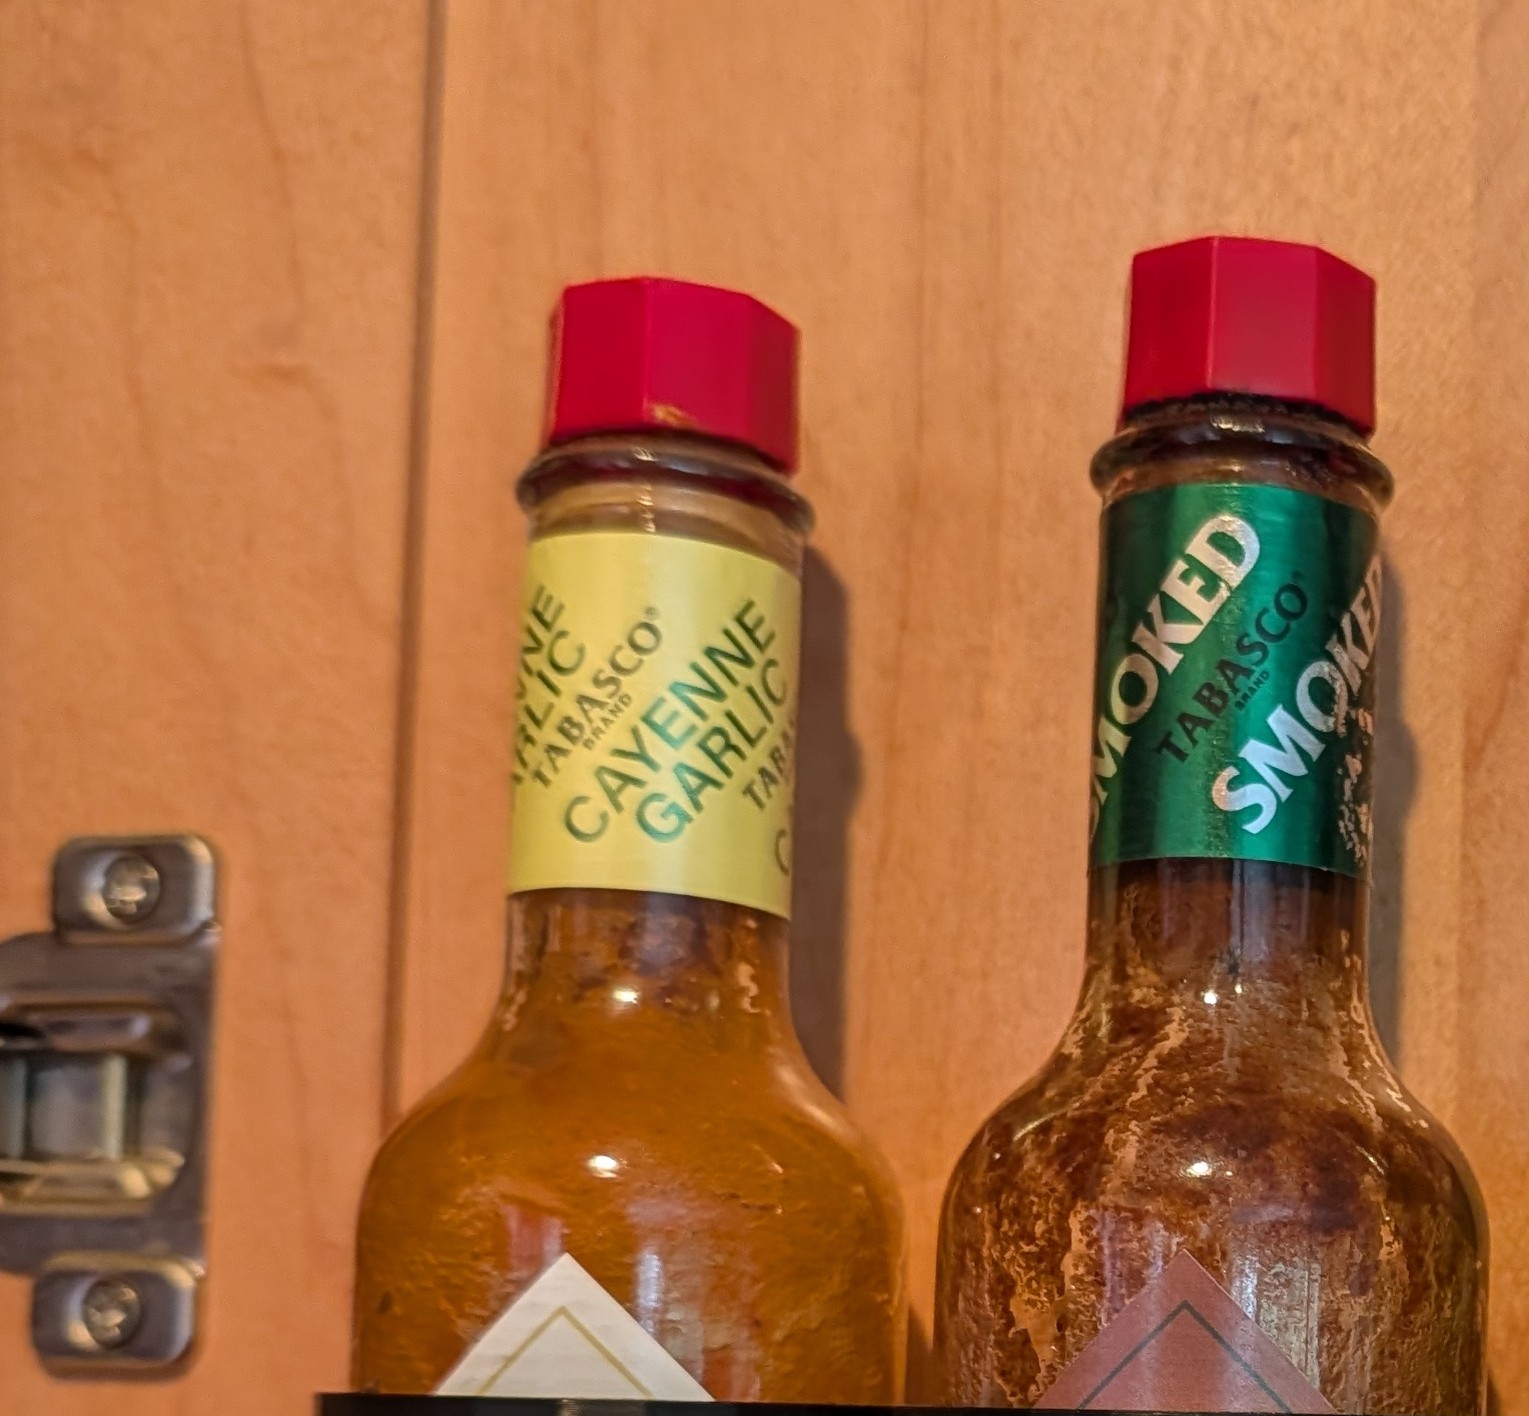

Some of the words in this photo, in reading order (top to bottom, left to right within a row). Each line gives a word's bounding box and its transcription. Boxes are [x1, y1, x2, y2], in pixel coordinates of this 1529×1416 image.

[564, 599, 775, 843] CAYENNE
[583, 693, 632, 750] BRAND
[636, 658, 787, 844] GARLIC
[1090, 513, 1260, 842] MOKED
[1212, 555, 1382, 835] SMOKED
